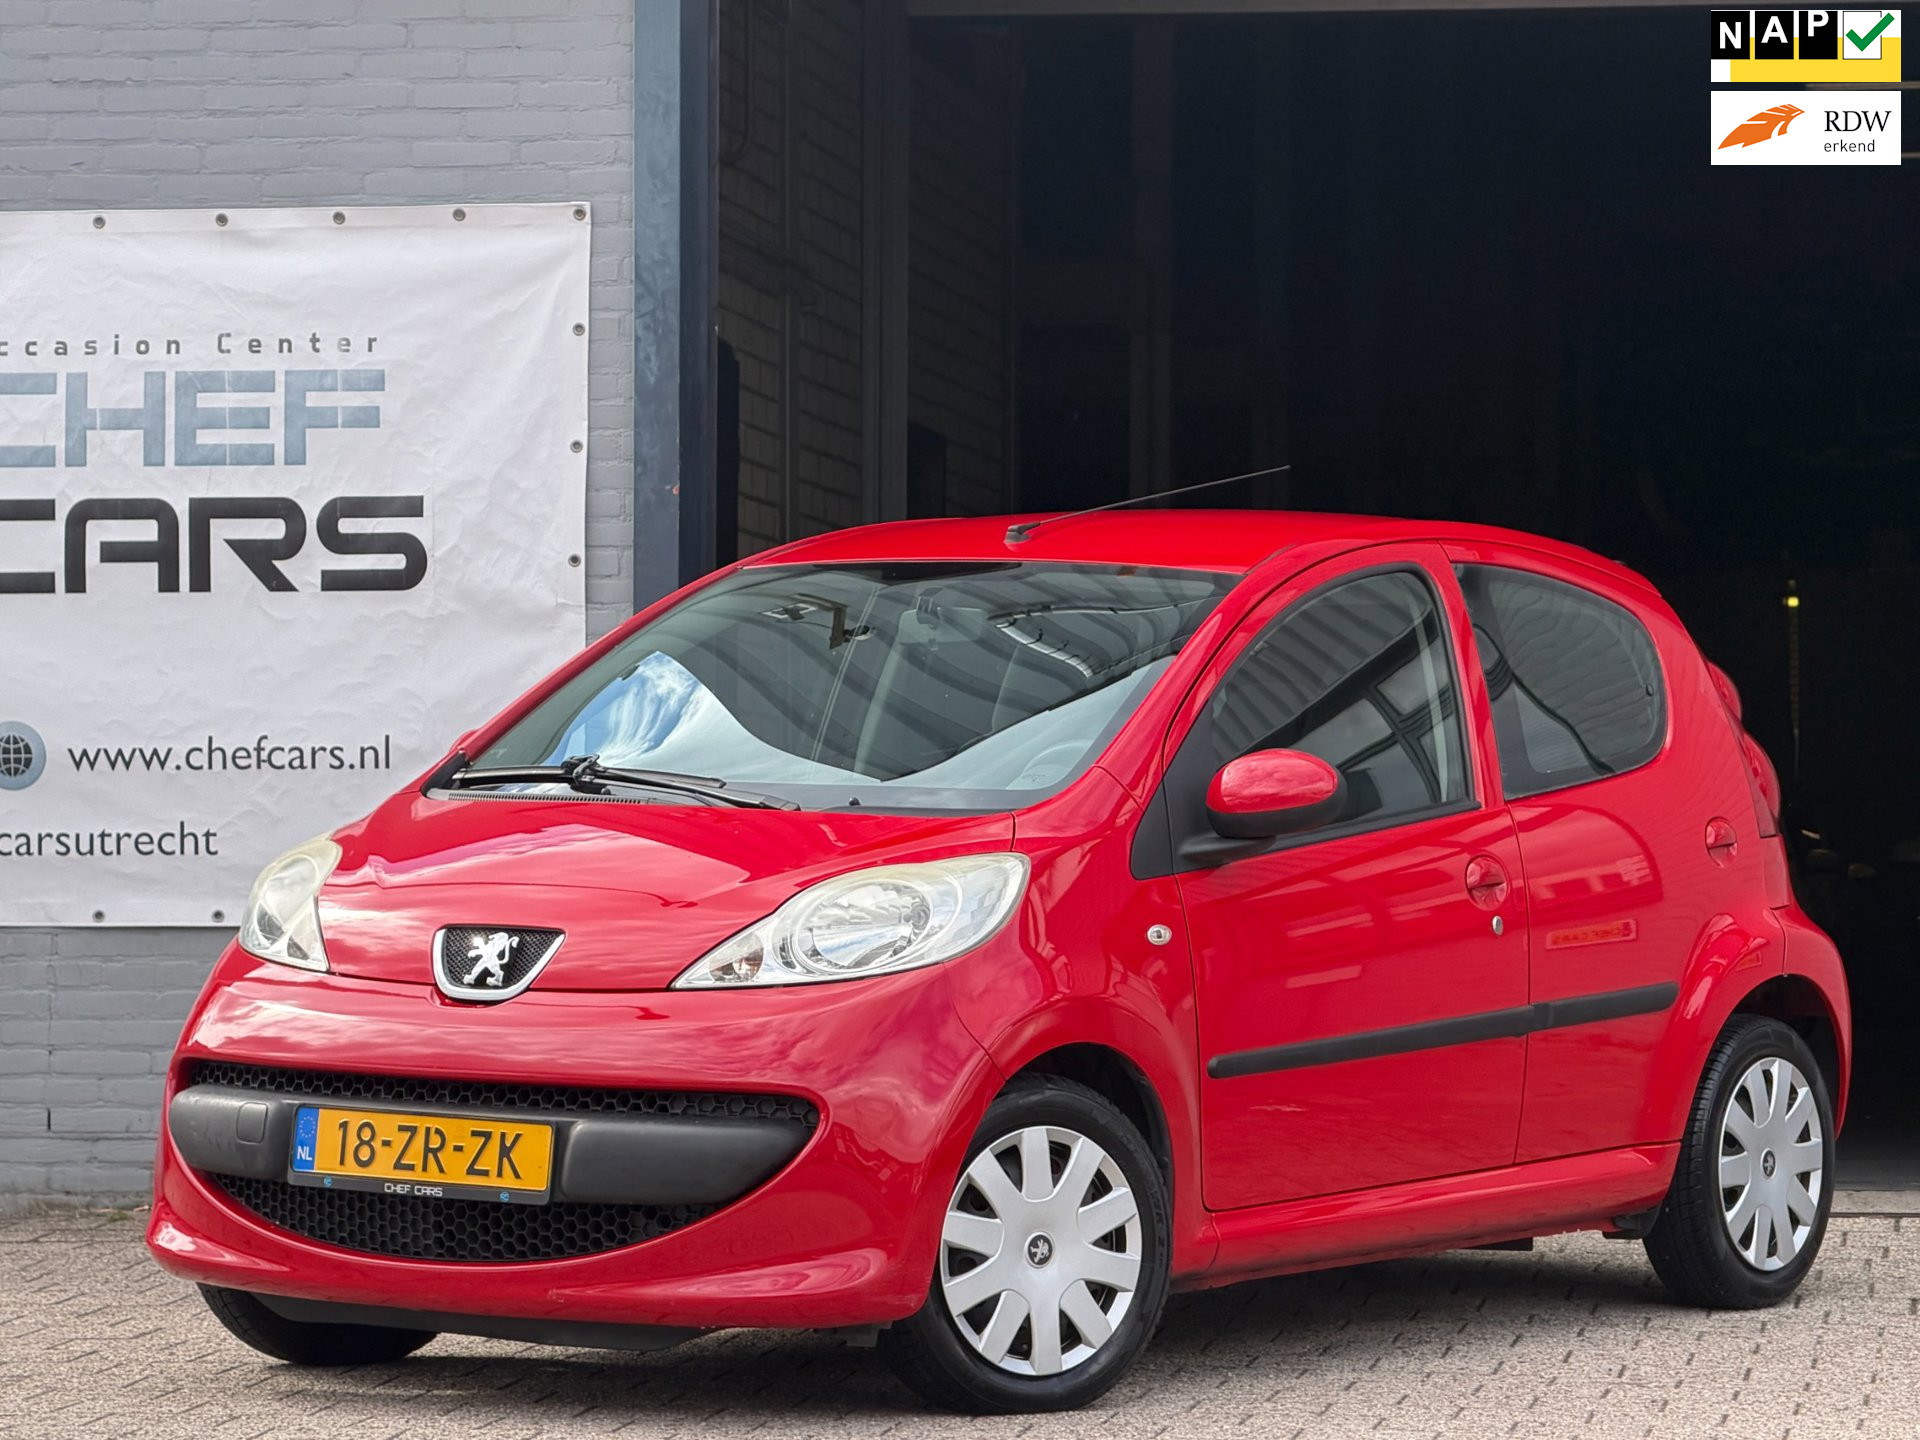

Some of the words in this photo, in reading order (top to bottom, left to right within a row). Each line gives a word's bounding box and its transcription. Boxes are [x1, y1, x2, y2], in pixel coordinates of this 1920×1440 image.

[217, 332, 377, 354] Center
[67, 734, 391, 771] www.chefcars.nl
[0, 820, 219, 856] carsutrecht
[296, 1146, 313, 1161] NL
[338, 1119, 523, 1180] 18-ZR-ZK
[384, 1182, 411, 1194] CHEF
[414, 1185, 443, 1197] CARS
